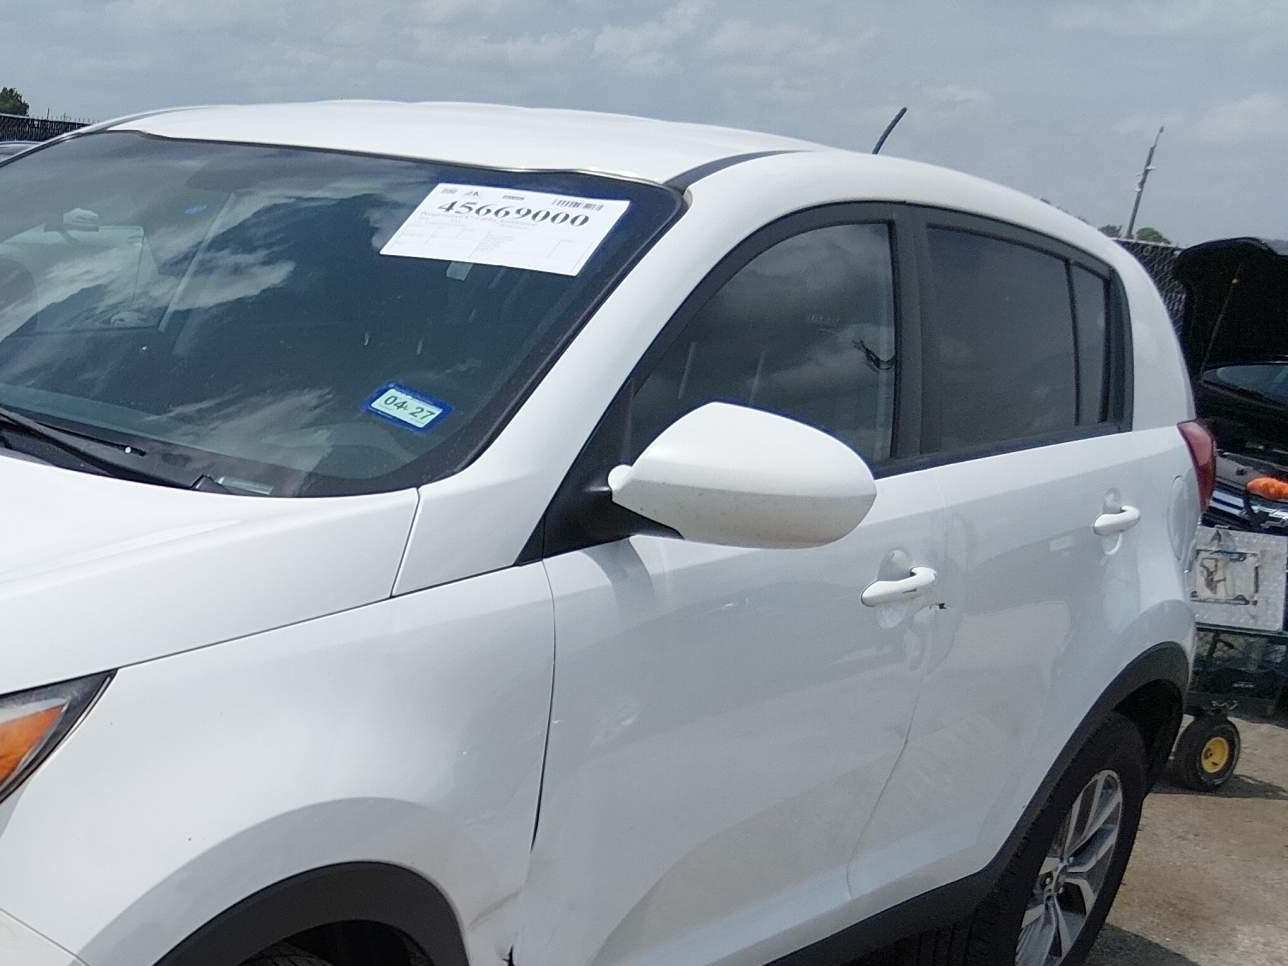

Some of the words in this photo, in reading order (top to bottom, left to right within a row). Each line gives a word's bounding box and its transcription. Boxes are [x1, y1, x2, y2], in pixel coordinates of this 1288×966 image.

[437, 200, 590, 228] 45669000
[383, 395, 408, 410] 04
[409, 406, 435, 420] 27
